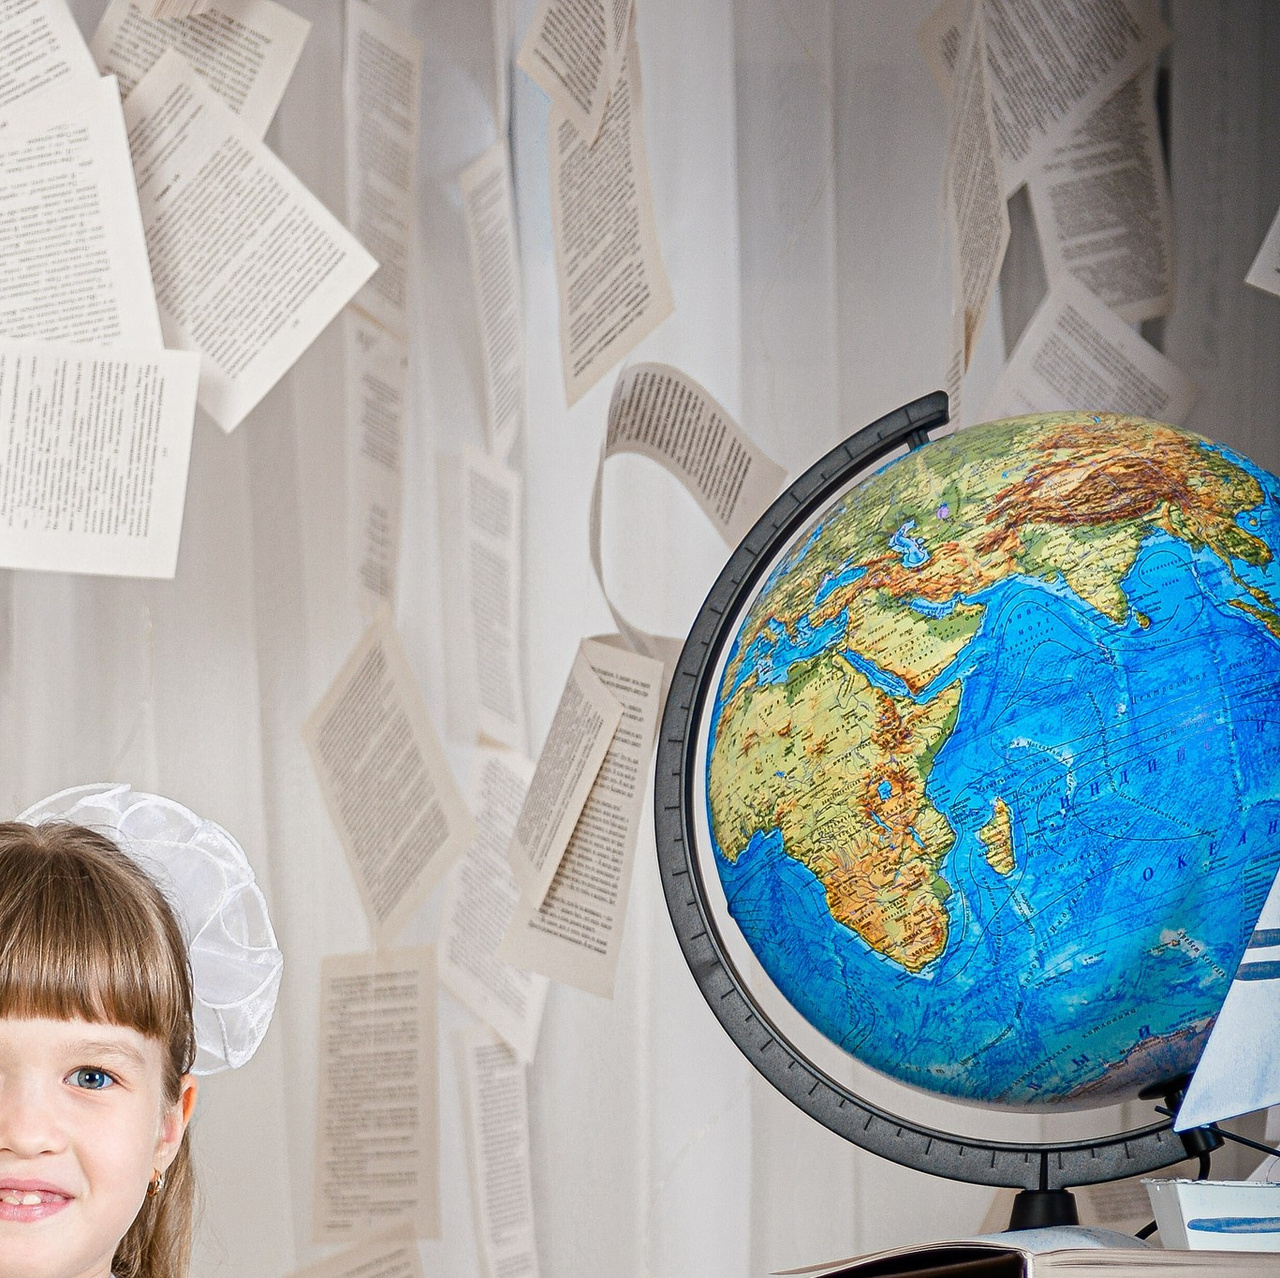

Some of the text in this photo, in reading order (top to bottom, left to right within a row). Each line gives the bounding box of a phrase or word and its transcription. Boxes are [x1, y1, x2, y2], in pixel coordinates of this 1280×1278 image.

[1018, 617, 1051, 635] МОРЕ
[1131, 671, 1208, 705] Центральная
[1142, 819, 1279, 882] ОКЕАН
[880, 897, 907, 914] БОТСВАНА
[911, 943, 934, 957] АФРИКА
[1176, 930, 1201, 954] хребет
[1081, 1008, 1138, 1040] котловина
